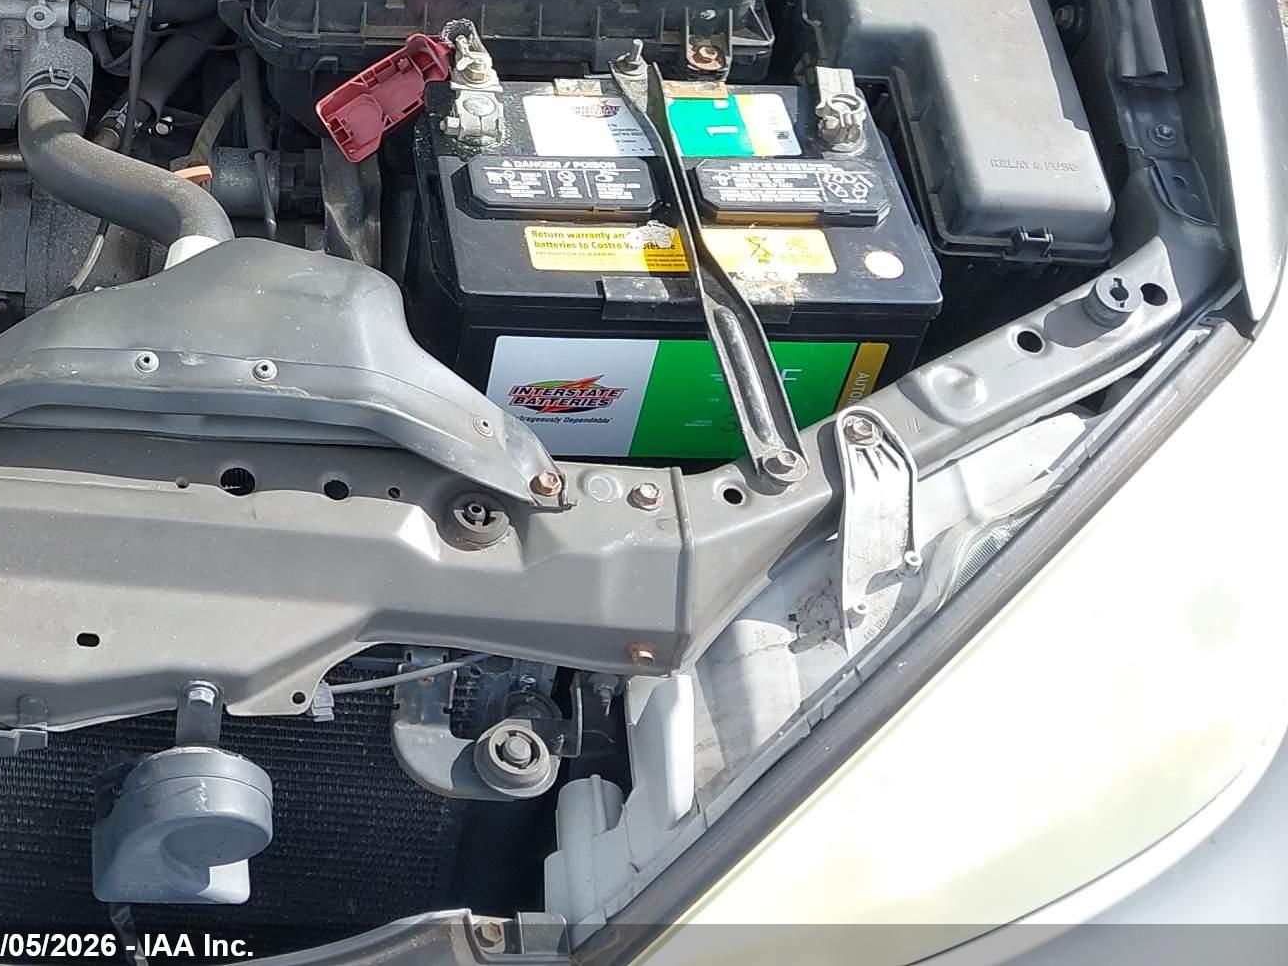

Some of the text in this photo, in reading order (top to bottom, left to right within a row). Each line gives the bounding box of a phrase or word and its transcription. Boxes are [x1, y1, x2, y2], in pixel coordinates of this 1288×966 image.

[513, 160, 561, 169] DANGER
[573, 160, 617, 169] POISON
[991, 159, 1029, 170] RELAY
[1045, 162, 1080, 172] FUSE
[531, 229, 631, 241] Return warranty an
[534, 239, 577, 249] batteries
[579, 240, 589, 249] to
[511, 386, 622, 398] INTERSTATE
[512, 397, 612, 407] BATTERIES
